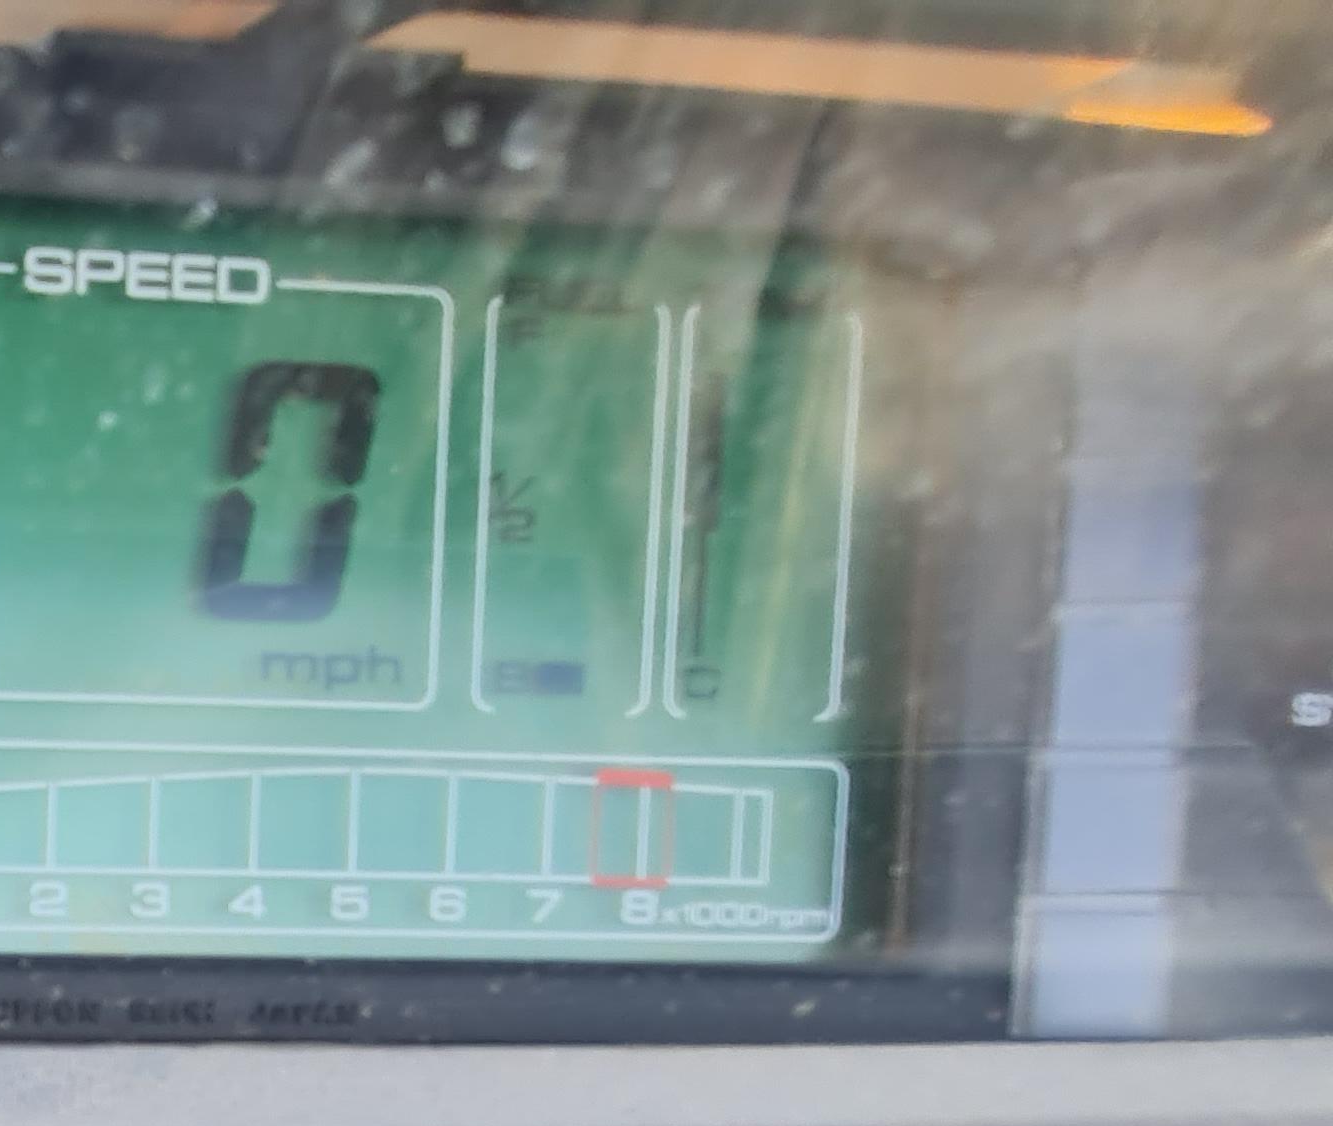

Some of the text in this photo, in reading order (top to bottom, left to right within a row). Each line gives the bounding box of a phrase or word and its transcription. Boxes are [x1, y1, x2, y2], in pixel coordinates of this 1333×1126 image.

[23, 246, 270, 304] SPEED
[196, 360, 381, 622] 0
[259, 644, 402, 690] mph
[30, 881, 68, 917] 2
[130, 882, 170, 917] 3
[228, 884, 266, 917] 4
[331, 885, 369, 921] 5
[429, 887, 467, 923] 6
[526, 889, 562, 924] 7
[620, 890, 659, 925] 8
